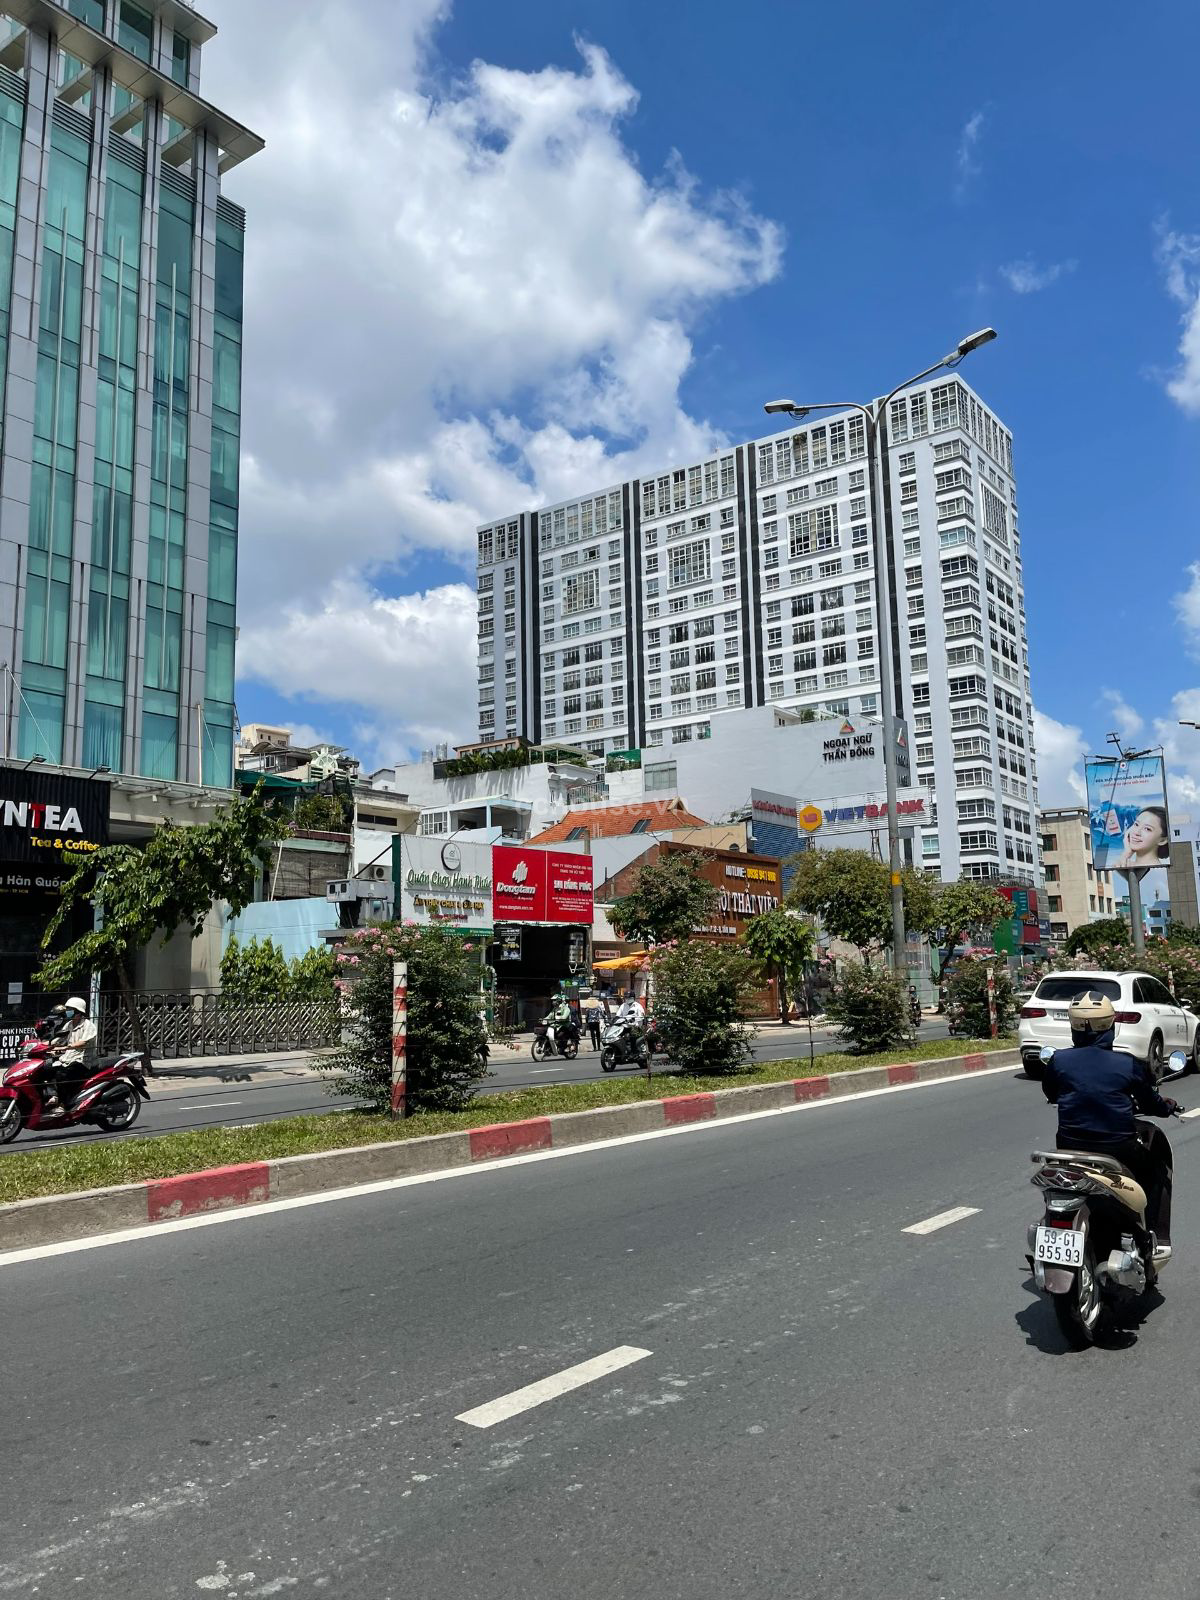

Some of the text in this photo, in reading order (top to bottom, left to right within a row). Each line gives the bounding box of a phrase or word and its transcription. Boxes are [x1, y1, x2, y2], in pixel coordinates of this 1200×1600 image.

[823, 733, 873, 752] NGOẠI NGỮ
[31, 837, 52, 848] Tea
[53, 838, 63, 849] &
[7, 875, 31, 886] Hàn
[406, 869, 430, 886] Quán
[496, 882, 536, 895] Dongtam
[1044, 1230, 1076, 1247] 59-G1
[1038, 1244, 1080, 1263] 955.93
